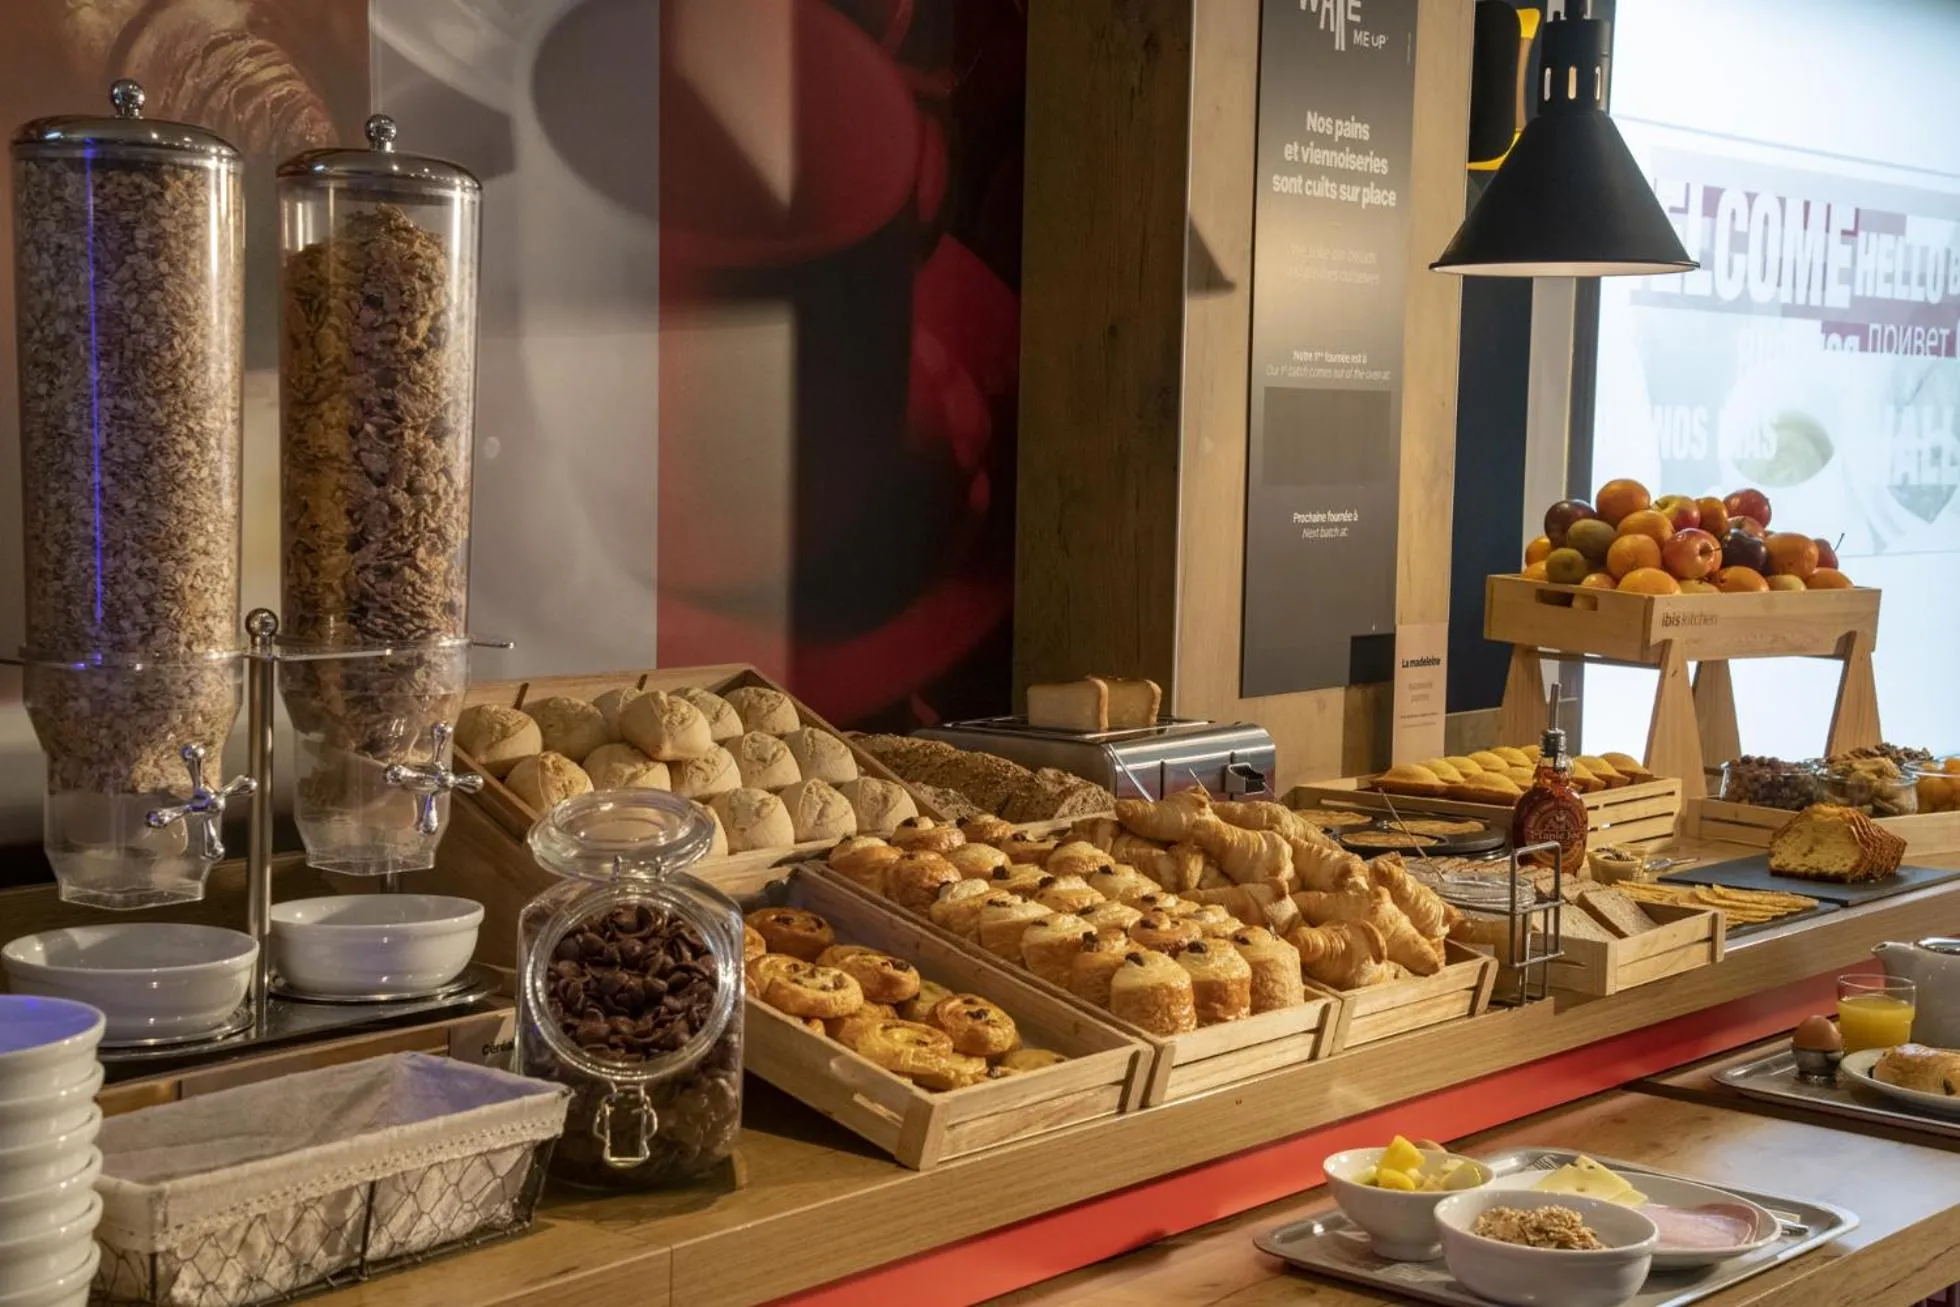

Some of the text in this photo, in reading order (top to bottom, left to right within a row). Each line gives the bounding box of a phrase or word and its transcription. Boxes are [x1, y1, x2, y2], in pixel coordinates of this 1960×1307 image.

[1353, 29, 1370, 47] ME
[1306, 110, 1370, 142] Nos pains
[1284, 141, 1388, 175] et viennoiseries
[1272, 173, 1397, 209] sont cuits sur place
[1854, 231, 1947, 304] HELLO
[1293, 511, 1326, 523] Prochaine
[1327, 509, 1352, 522] fournée
[1661, 611, 1719, 627] ibis kitchen
[1401, 656, 1441, 668] La madeleine
